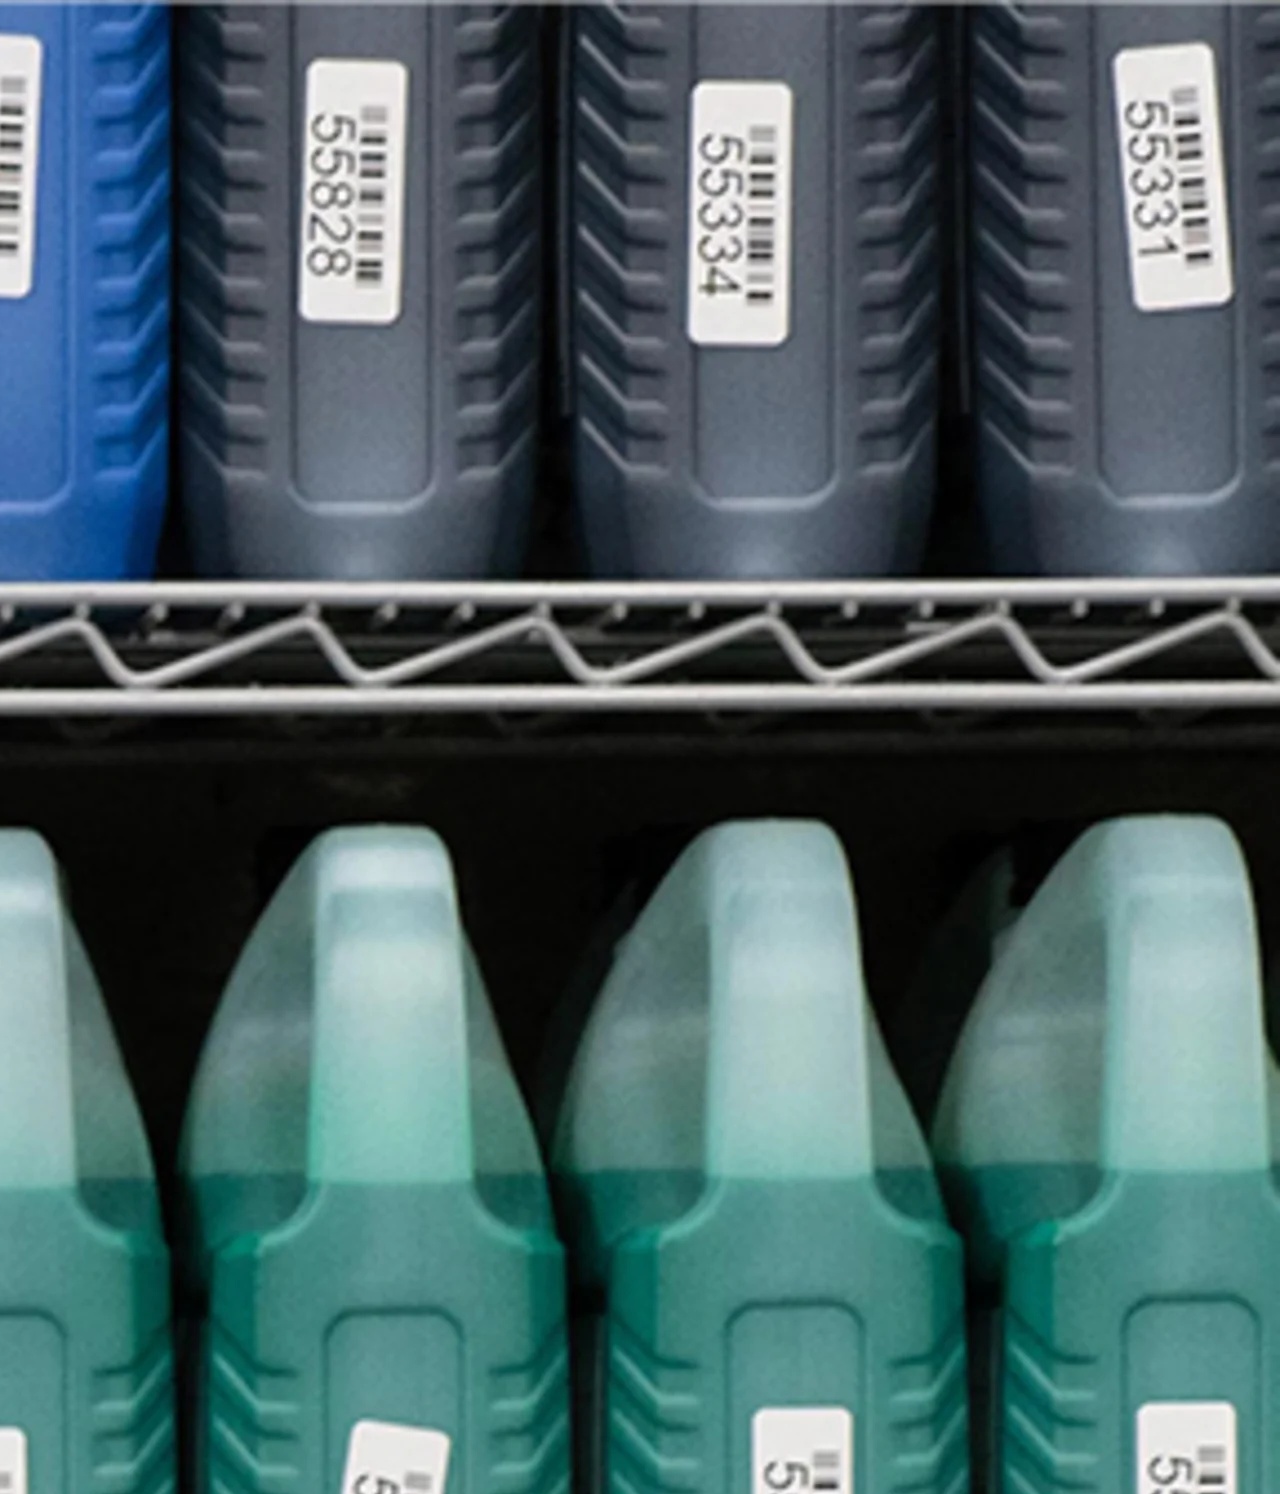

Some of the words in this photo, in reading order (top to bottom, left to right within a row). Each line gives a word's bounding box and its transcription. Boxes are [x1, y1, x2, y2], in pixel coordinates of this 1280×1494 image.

[307, 112, 354, 277] 55828
[697, 133, 743, 296] 55334
[1124, 99, 1177, 262] 55331
